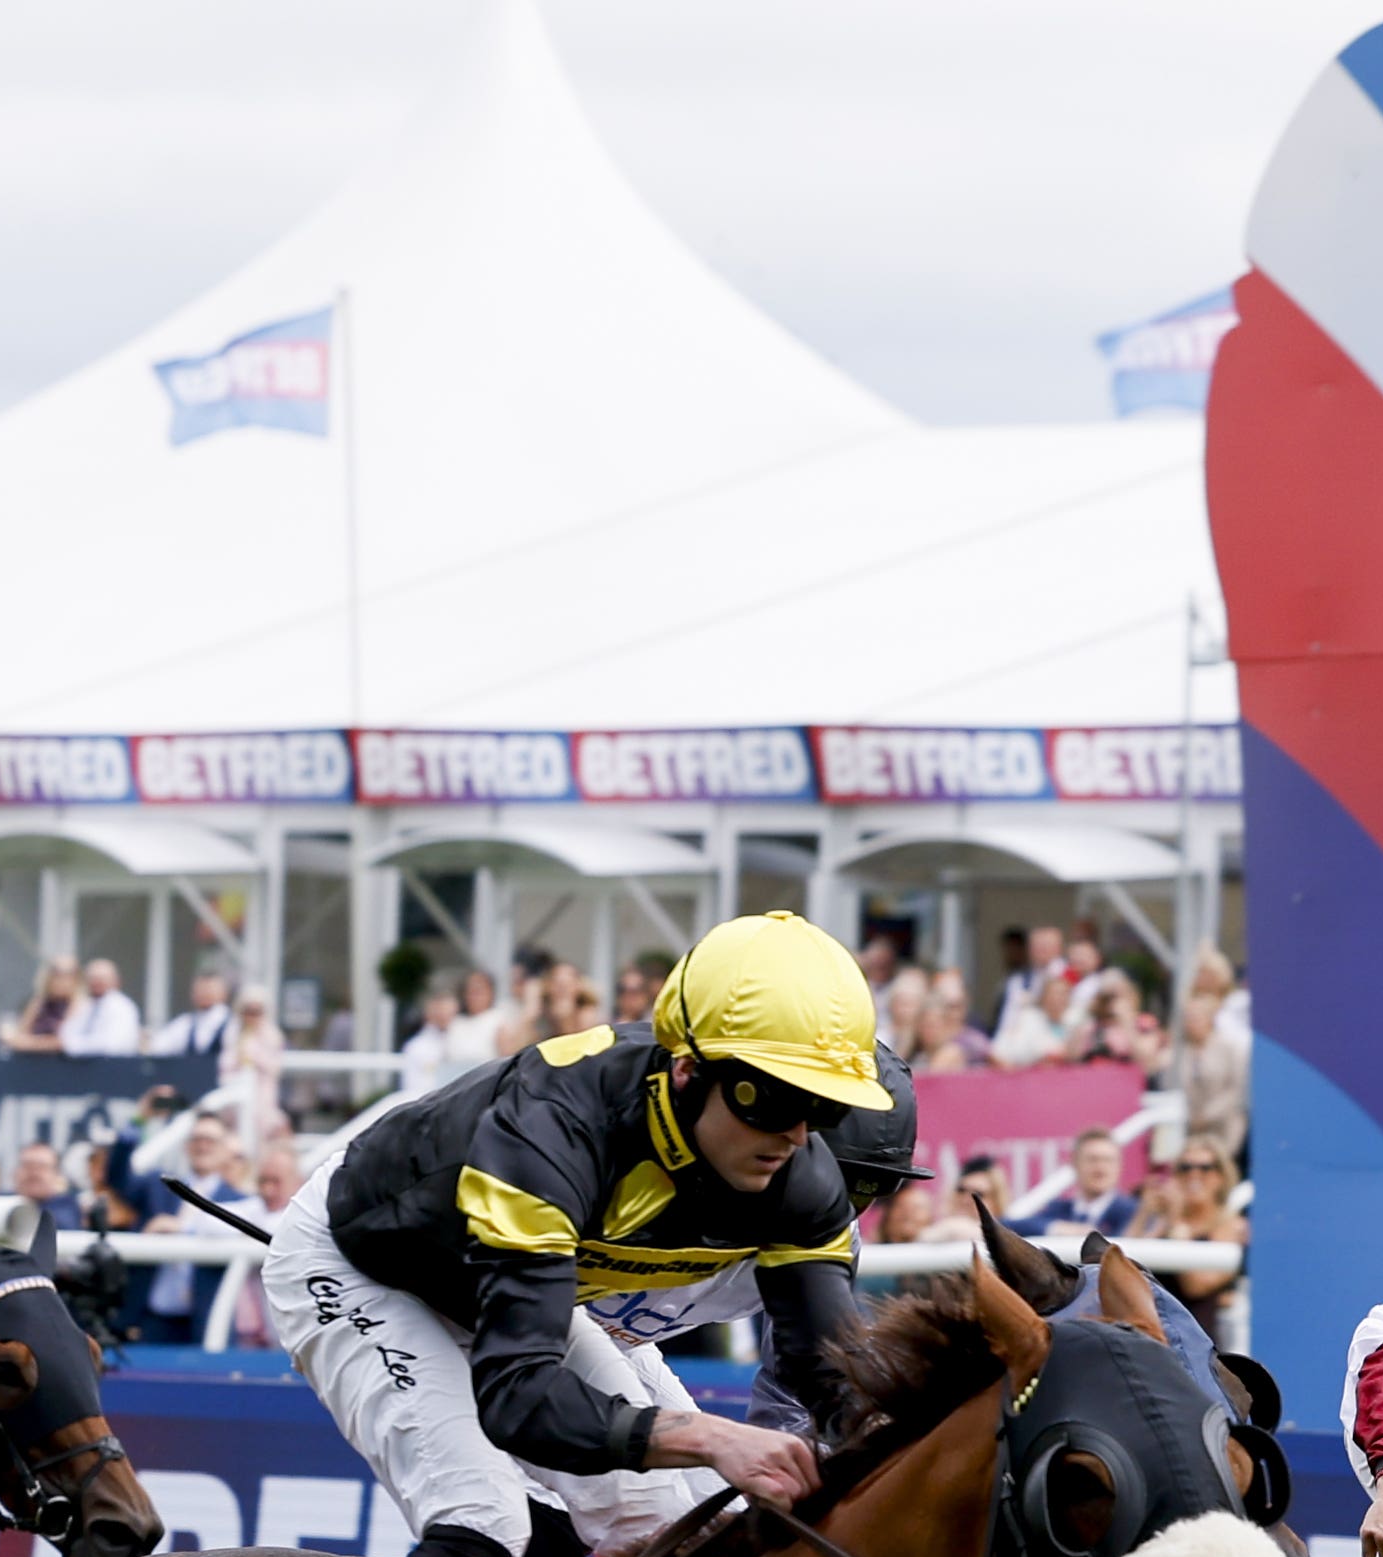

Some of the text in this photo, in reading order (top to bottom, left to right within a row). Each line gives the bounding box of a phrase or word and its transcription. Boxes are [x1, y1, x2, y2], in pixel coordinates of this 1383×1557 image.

[138, 734, 350, 799] BETFRED
[360, 734, 564, 798] BETFRED
[577, 731, 810, 798] BETFRED
[823, 731, 1043, 797] BETFRED
[376, 1346, 417, 1390] Lee
